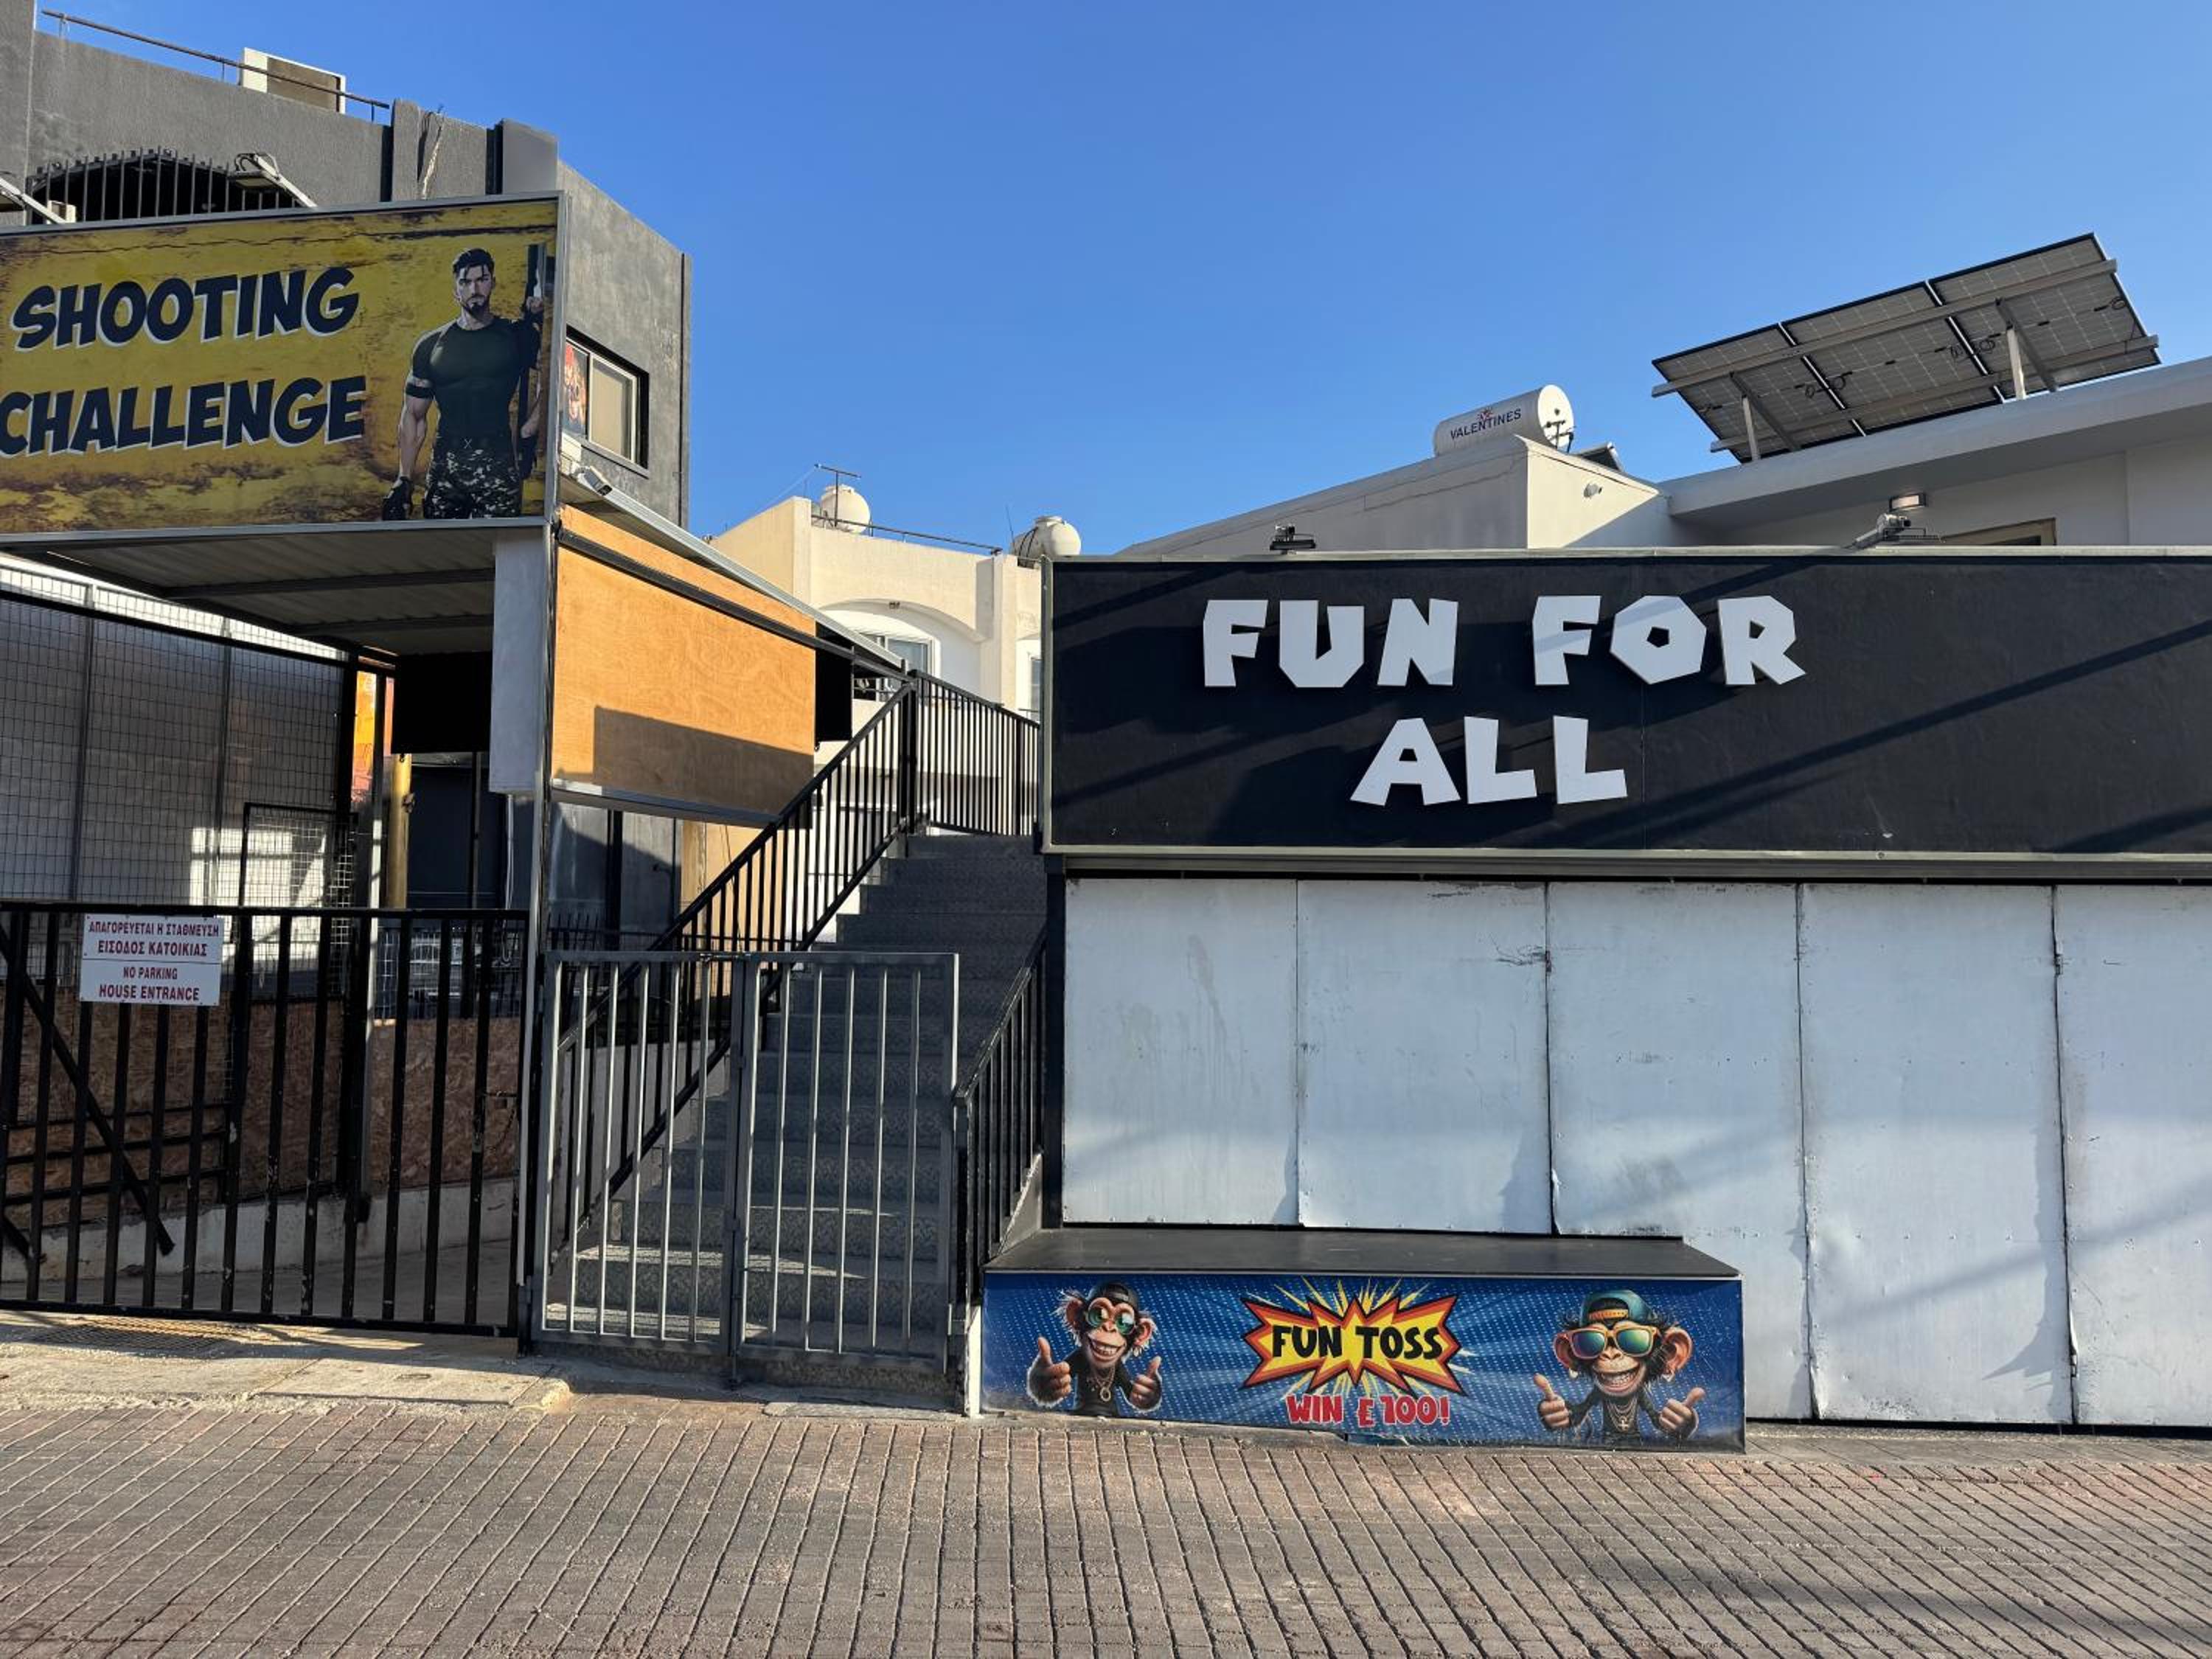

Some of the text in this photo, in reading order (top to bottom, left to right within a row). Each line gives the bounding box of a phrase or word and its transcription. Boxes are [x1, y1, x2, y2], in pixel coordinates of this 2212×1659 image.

[10, 268, 359, 352] SHOOTING
[0, 375, 366, 459] CHALLENGE
[1450, 408, 1521, 440] VALENTINES
[1203, 595, 1806, 688] FUN FOR
[1350, 715, 1627, 806] ALL
[88, 921, 154, 935] ΑΠΑΓΟΡΕΥΕΤΑΙ
[167, 924, 219, 936] ΣΤΑΘΜΕΥΣΗ
[98, 940, 207, 956] ΕΙΣΟΔΟΣ ΚΑΤΟΙΚΙΑΣ
[123, 967, 178, 980] NO PARKING
[100, 984, 200, 1001] HOUSE ENTRANCE
[1272, 1325, 1443, 1360] FUN TOSS
[1286, 1394, 1344, 1425] WIN
[1379, 1394, 1451, 1426] 100!
